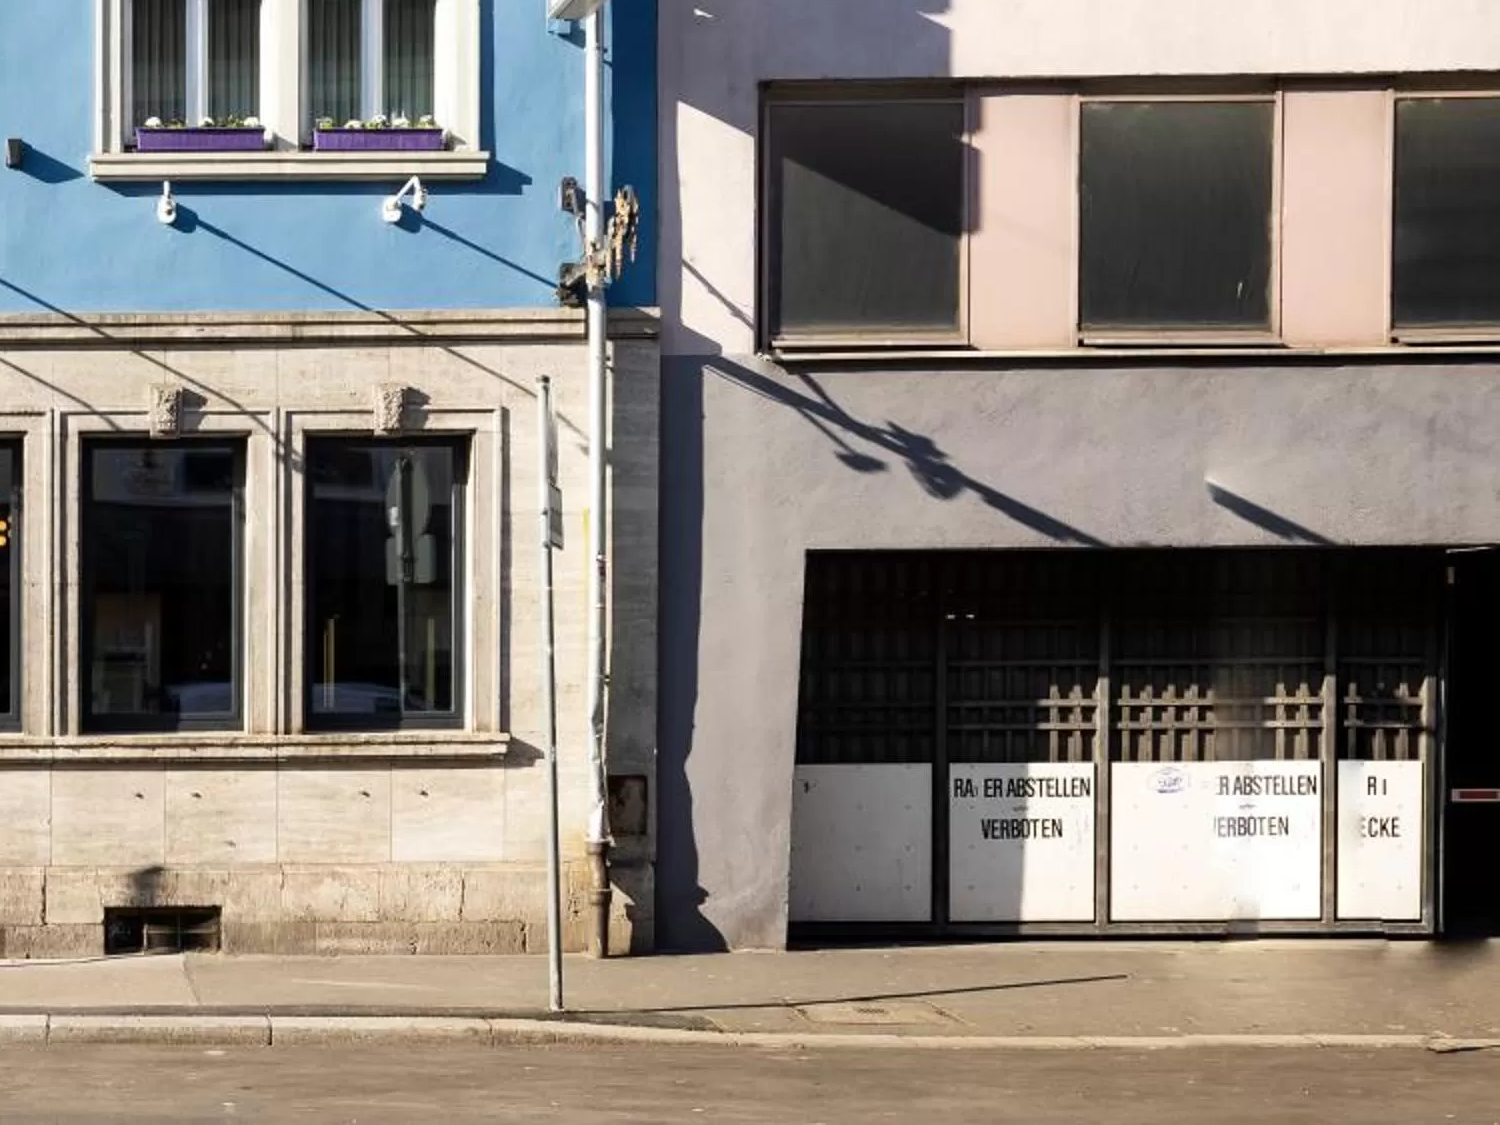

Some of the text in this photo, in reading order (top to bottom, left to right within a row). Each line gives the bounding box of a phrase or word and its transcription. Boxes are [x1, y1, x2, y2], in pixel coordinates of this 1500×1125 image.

[1006, 777, 1091, 797] ABSTELLEN
[1232, 774, 1318, 795] ABSTELLEN
[981, 818, 1063, 839] VERBOTEN
[1213, 815, 1290, 838] ERBOTEN
